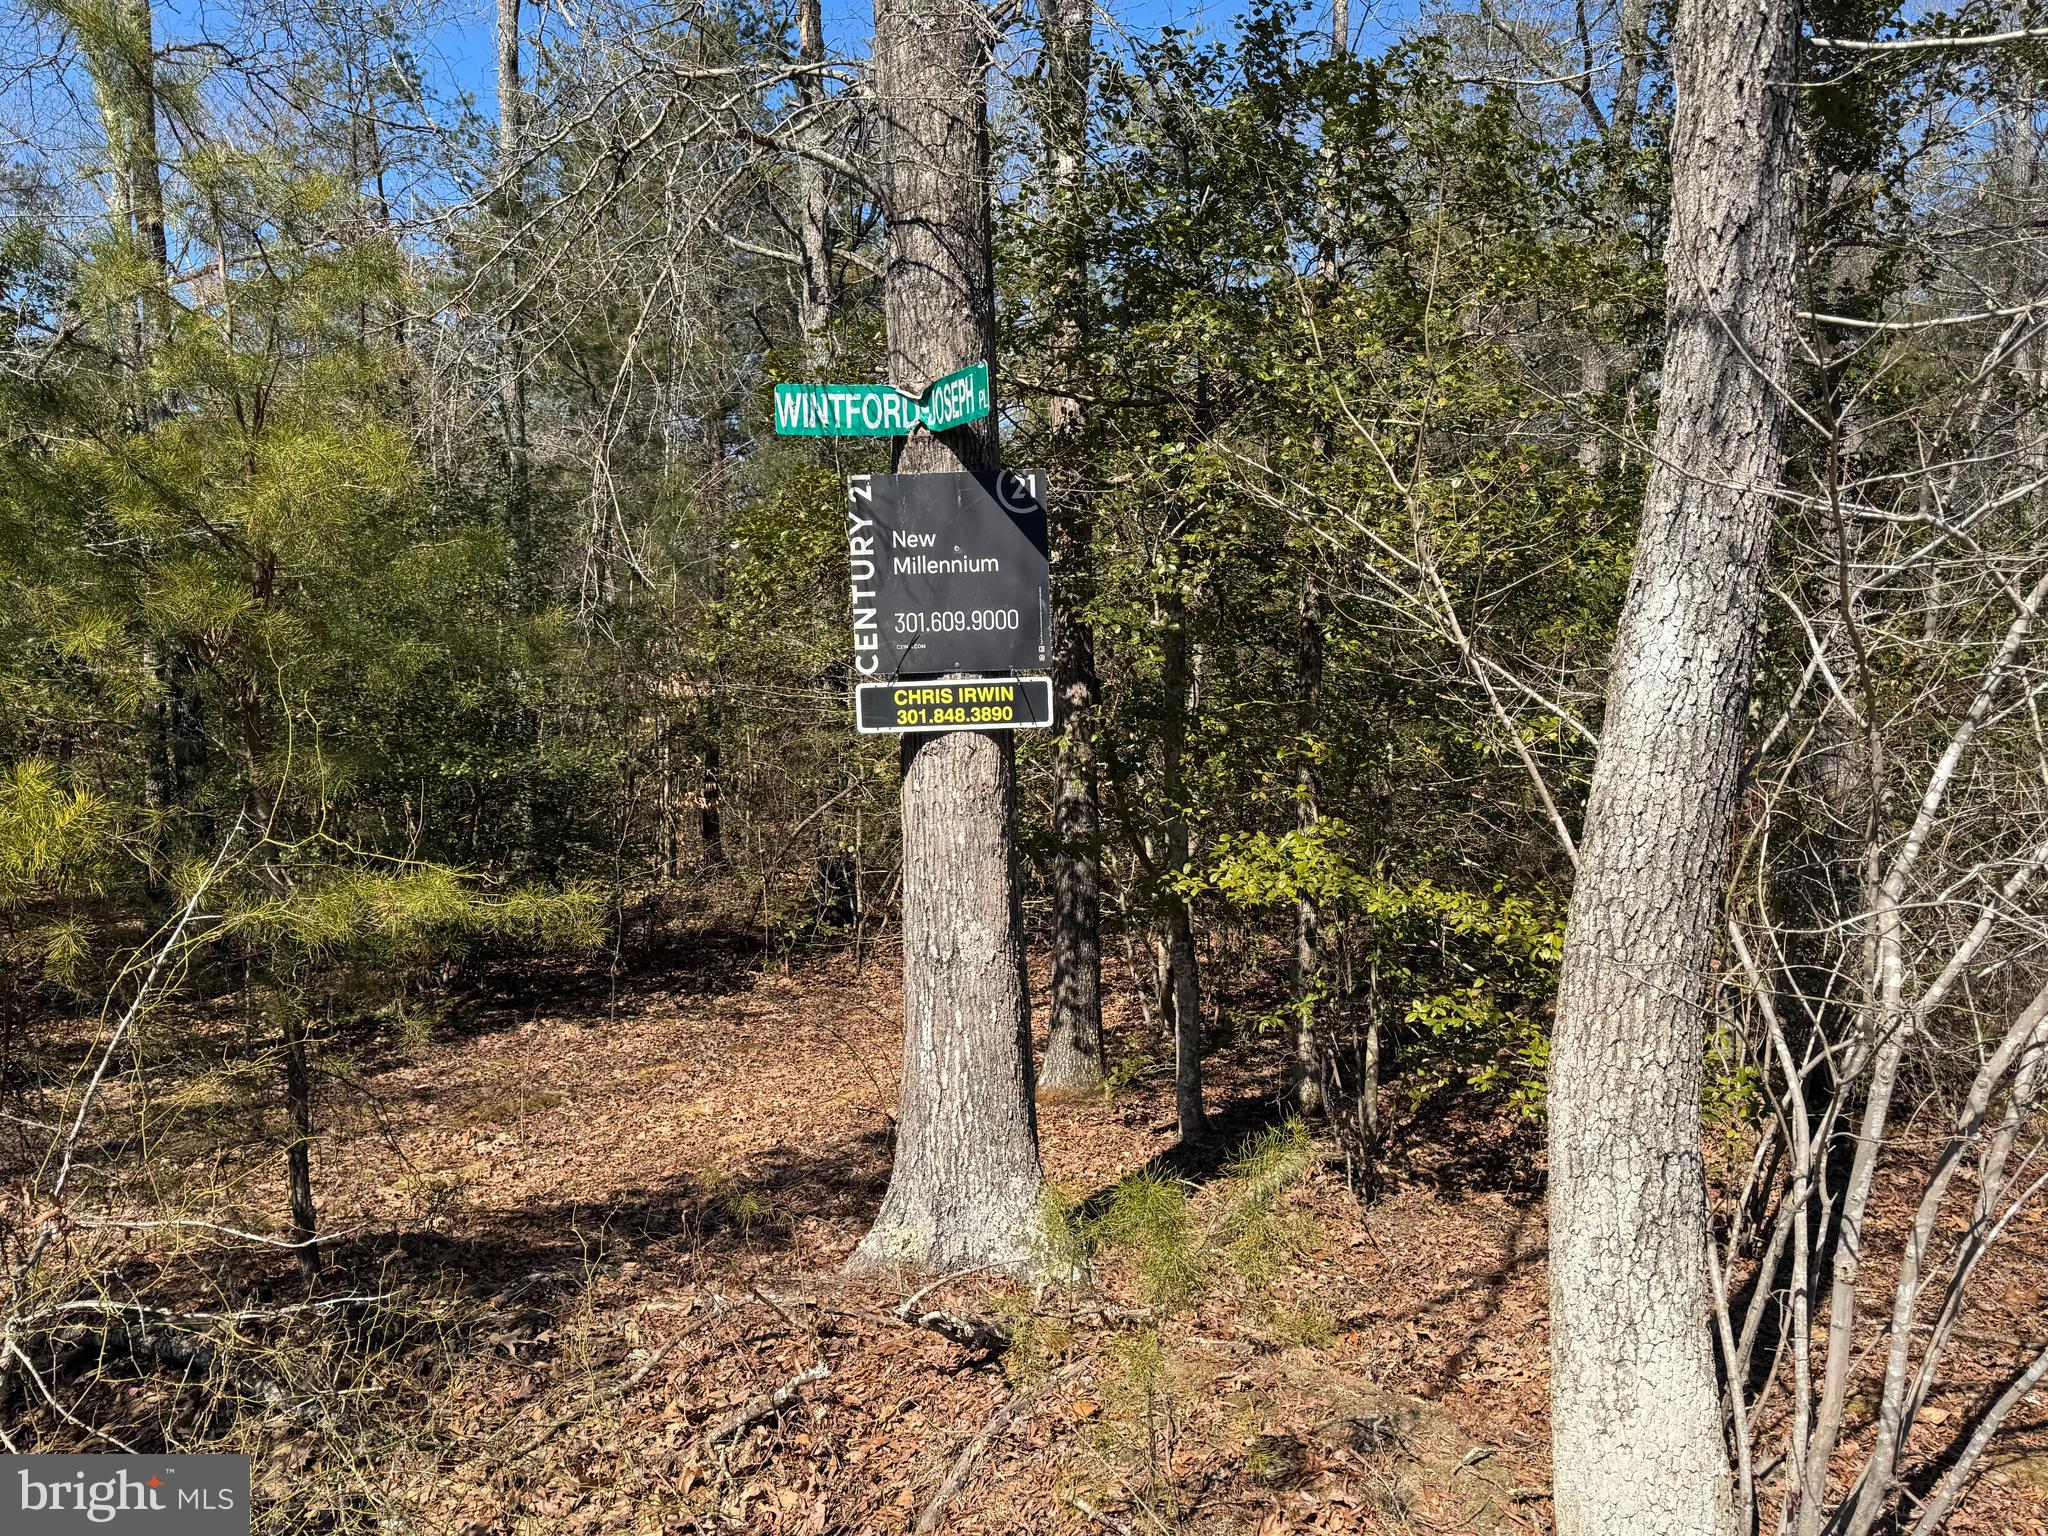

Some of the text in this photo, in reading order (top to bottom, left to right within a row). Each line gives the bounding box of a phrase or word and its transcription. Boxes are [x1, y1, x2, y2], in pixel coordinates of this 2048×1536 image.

[978, 388, 989, 411] PL
[1010, 474, 1036, 499] 21
[892, 530, 936, 549] New
[848, 474, 879, 676] CENTURY 21
[893, 555, 999, 576] Millennium
[894, 609, 1019, 634] 301.609.9000
[894, 686, 1014, 706] CHRIS IRWIN
[896, 706, 1013, 725] 301.848.3890
